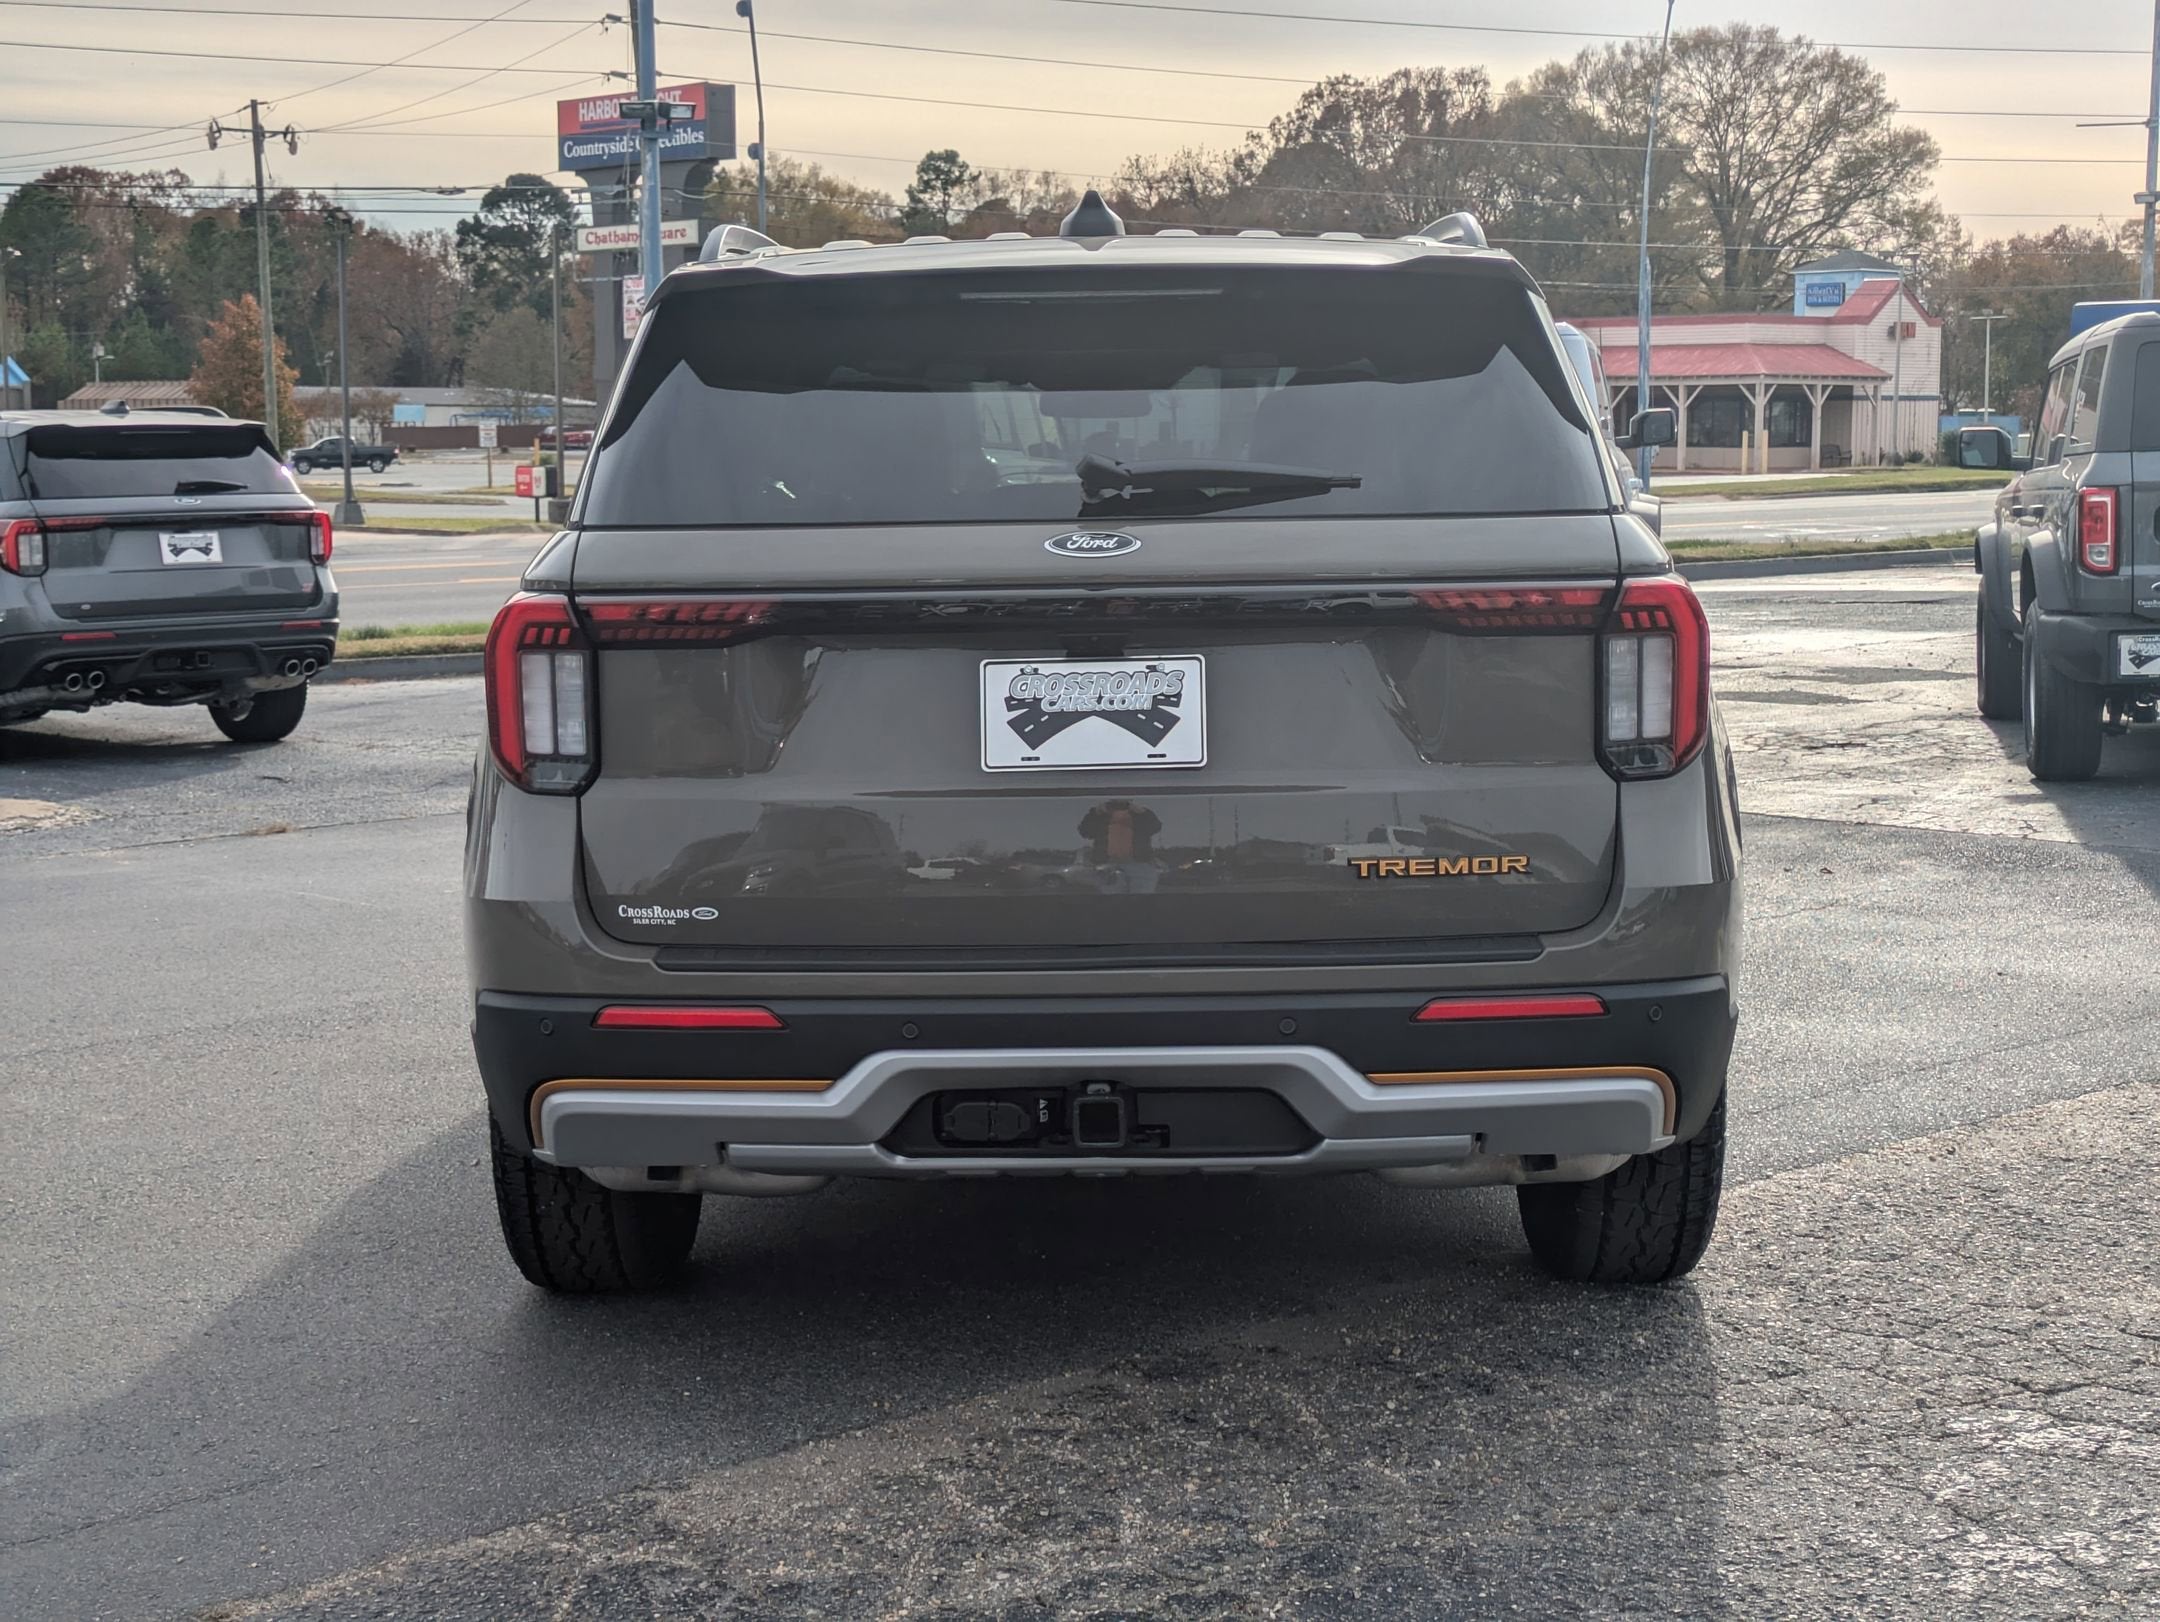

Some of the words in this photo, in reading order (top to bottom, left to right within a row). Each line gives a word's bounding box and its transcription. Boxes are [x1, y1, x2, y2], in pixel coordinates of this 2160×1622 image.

[579, 100, 628, 121] HARBO
[564, 136, 634, 159] Countryside
[635, 127, 704, 150] Cectibles
[662, 228, 687, 240] uare
[1067, 534, 1119, 549] Ford
[1010, 670, 1184, 699] CROSSROADS
[1041, 694, 1153, 712] CARS.COM
[1349, 854, 1530, 877] TREMOR
